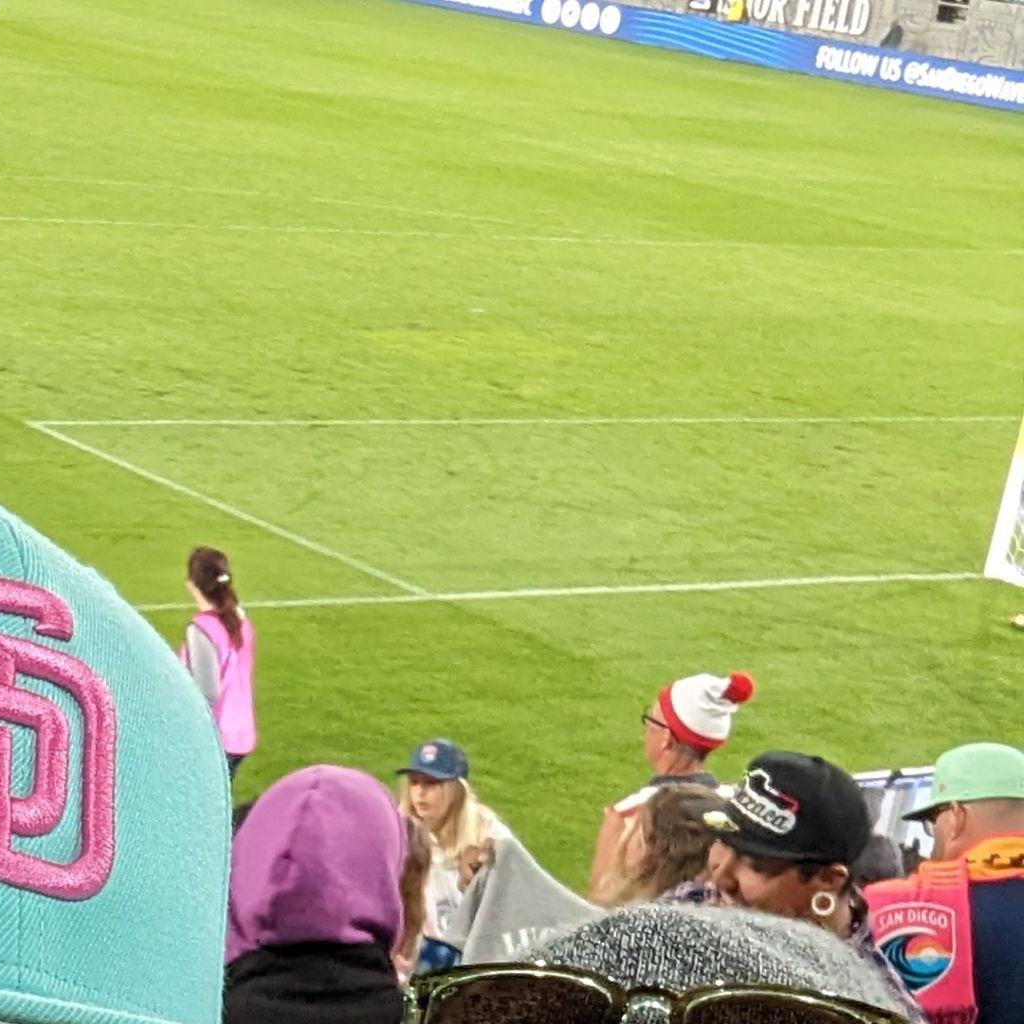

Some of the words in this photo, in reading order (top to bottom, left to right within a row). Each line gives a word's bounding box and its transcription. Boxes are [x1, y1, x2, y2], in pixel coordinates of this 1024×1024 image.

[793, 0, 871, 35] FIELD
[815, 45, 880, 77] FOLLOW
[880, 56, 902, 82] US
[877, 909, 904, 933] SAN
[907, 908, 949, 930] DIEGO
